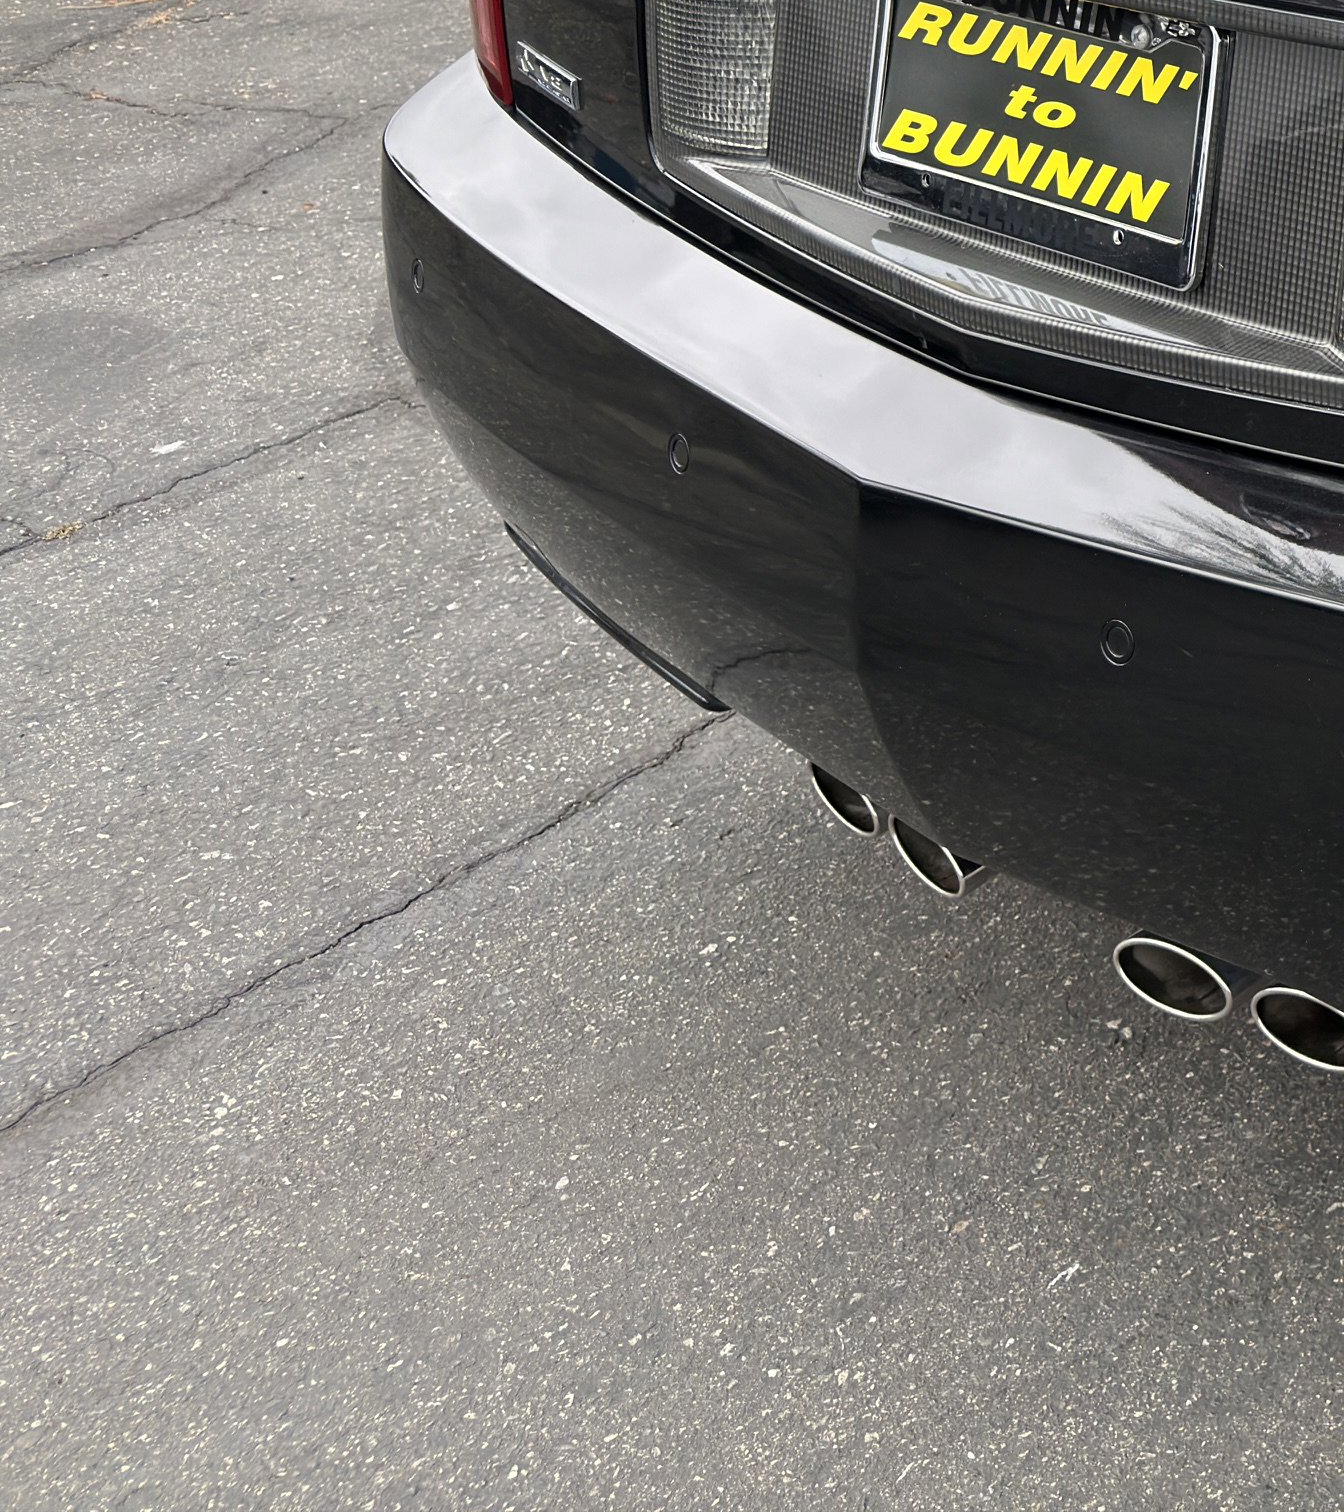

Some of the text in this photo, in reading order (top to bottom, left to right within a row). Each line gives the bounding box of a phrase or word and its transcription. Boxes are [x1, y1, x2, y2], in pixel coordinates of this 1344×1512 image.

[897, 0, 1199, 105] RUNNIN'
[1003, 84, 1077, 129] to
[881, 108, 1171, 224] BUNNIN
